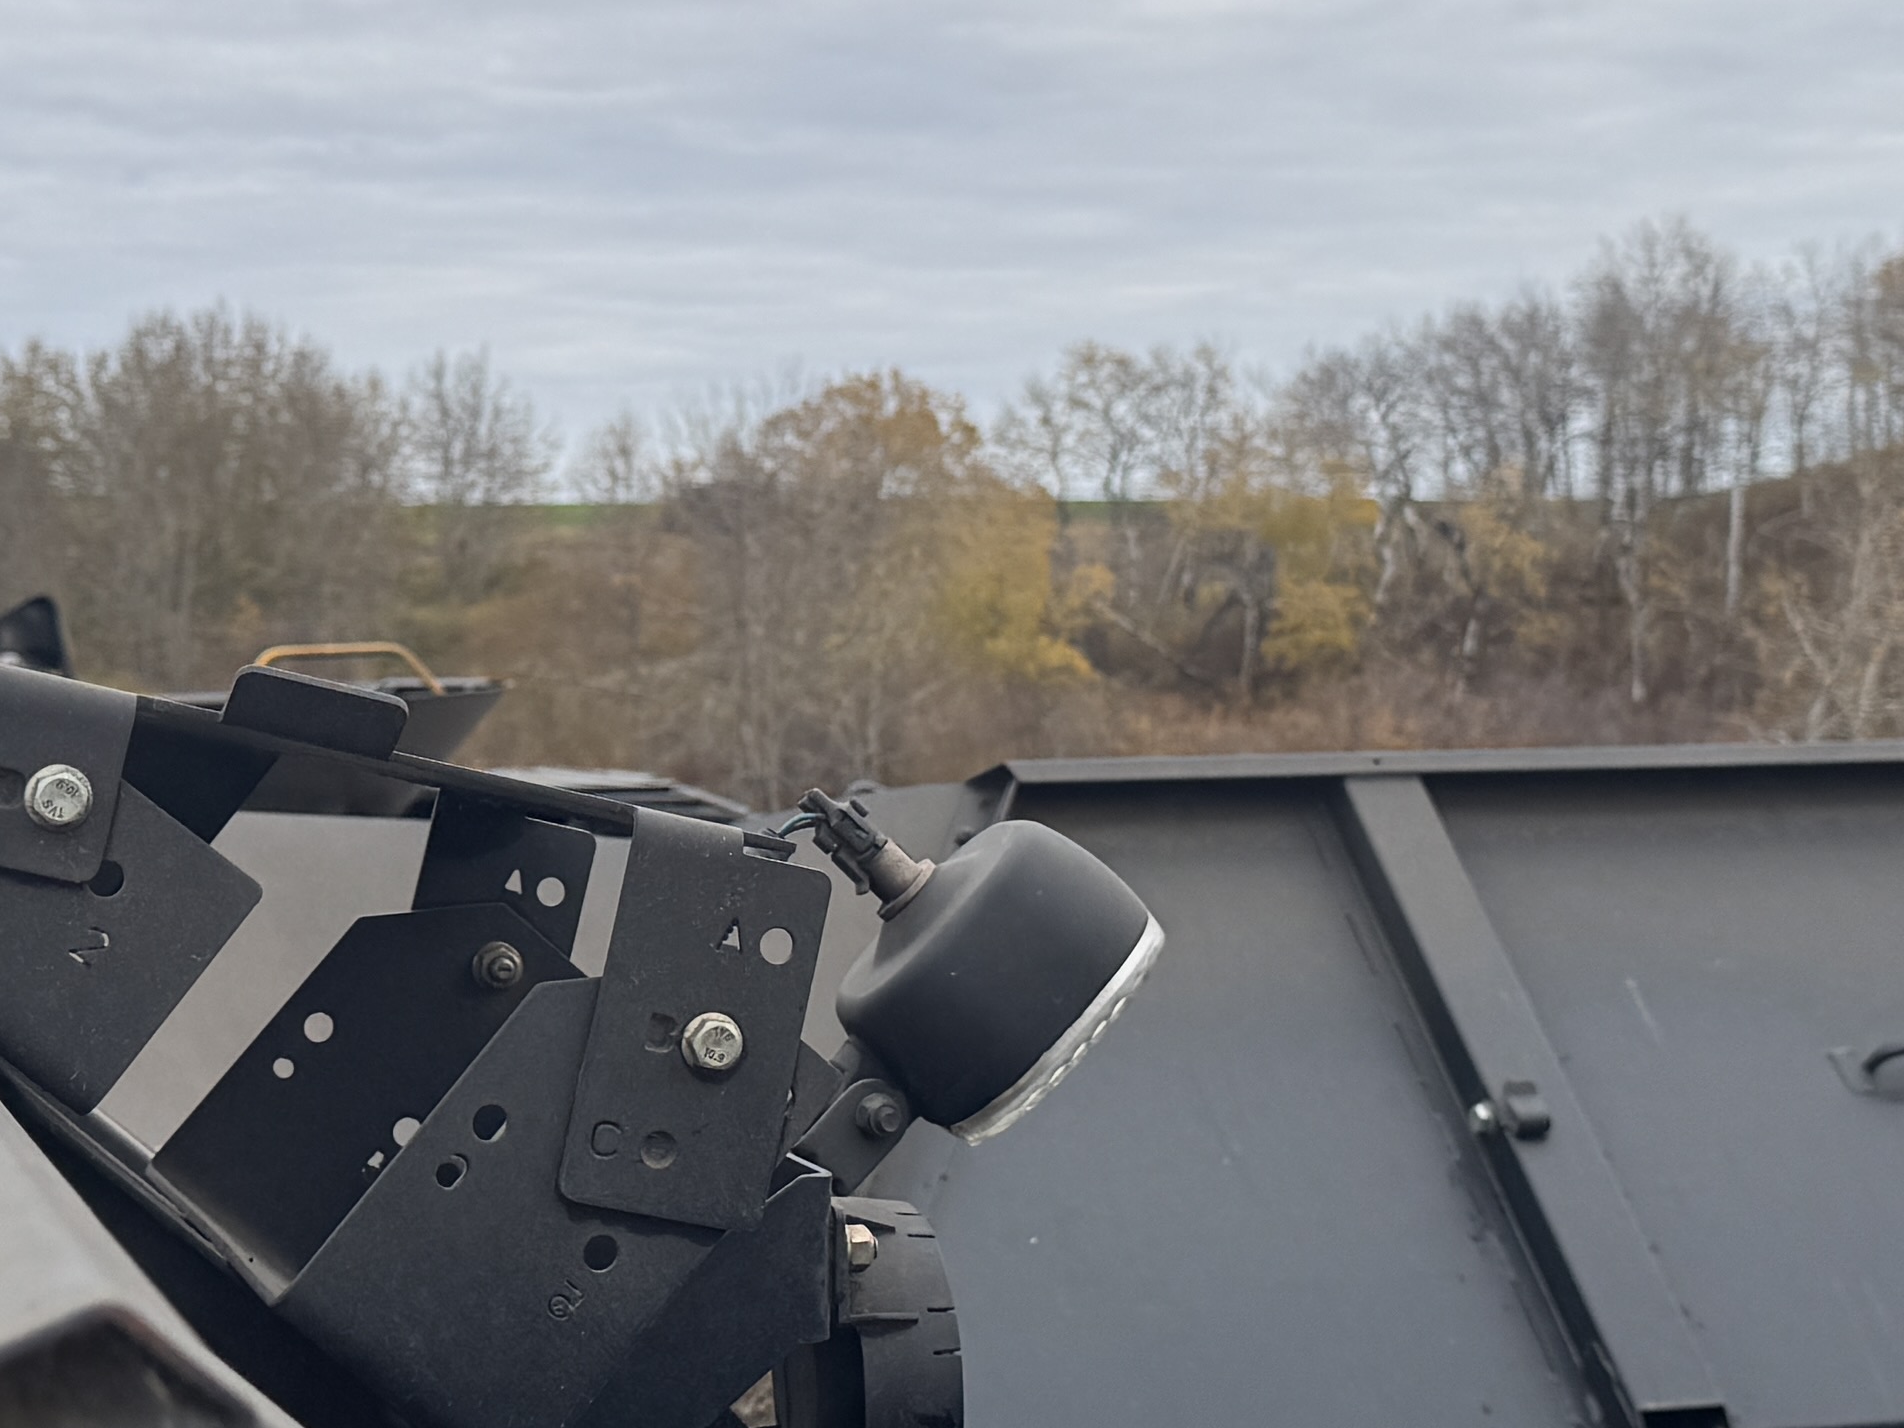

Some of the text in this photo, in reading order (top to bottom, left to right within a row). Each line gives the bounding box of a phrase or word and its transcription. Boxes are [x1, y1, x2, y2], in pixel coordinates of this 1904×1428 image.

[42, 799, 64, 818] TVS
[67, 926, 111, 967] 2
[714, 916, 743, 955] A
[703, 1047, 726, 1063] 10.9
[589, 1120, 624, 1160] C
